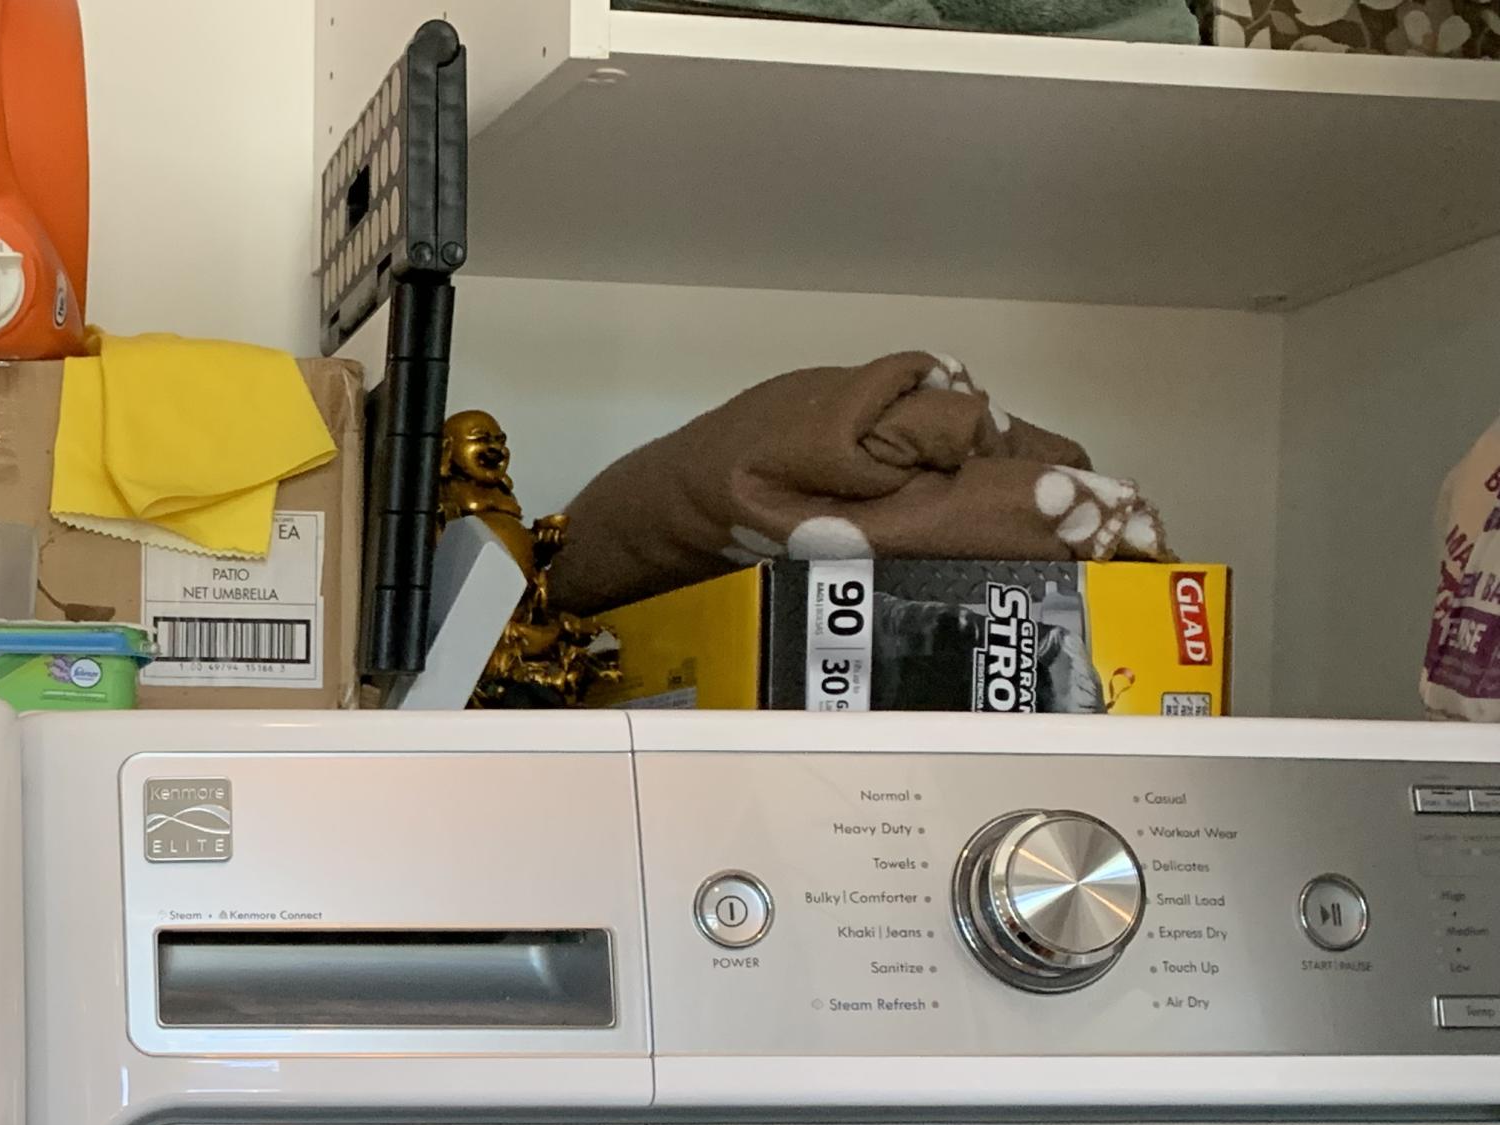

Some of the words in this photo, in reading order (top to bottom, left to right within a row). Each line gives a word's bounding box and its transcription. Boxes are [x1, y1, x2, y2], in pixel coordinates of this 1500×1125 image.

[278, 525, 300, 540] EA
[212, 568, 250, 582] PATIO
[183, 587, 208, 600] NET
[213, 588, 279, 600] UMBRELLA
[828, 581, 865, 636] 90
[1176, 578, 1207, 662] GLAD
[988, 588, 1026, 711] STRO
[822, 659, 850, 695] 30
[150, 787, 224, 800] Kenmore
[861, 790, 909, 801] Normal
[1145, 792, 1186, 804] Casual
[833, 823, 876, 836] Heavy
[882, 823, 911, 835] Duty
[1150, 827, 1200, 838] Workout
[1204, 828, 1238, 839] Wear
[152, 839, 224, 853] ELITE
[873, 858, 916, 869] Towels
[1153, 860, 1210, 872] Delicates
[805, 892, 840, 905] Bulky
[849, 891, 917, 903] Comforter
[1157, 893, 1191, 905] Small
[1195, 896, 1225, 906] Load
[170, 910, 202, 920] Steam
[227, 911, 276, 919] Kenmore
[280, 910, 322, 920] Connect
[838, 927, 875, 938] Khaki
[886, 926, 922, 938] Jeans
[1159, 926, 1202, 940] Express
[1207, 926, 1227, 941] Dry
[713, 957, 759, 968] POWER
[871, 962, 923, 973] Sanitize
[1162, 961, 1197, 973] Touch
[1201, 962, 1219, 975] Up
[830, 999, 872, 1011] Steam
[878, 998, 925, 1010] Refresh
[1166, 997, 1183, 1007] Air
[1188, 996, 1209, 1009] Dry
